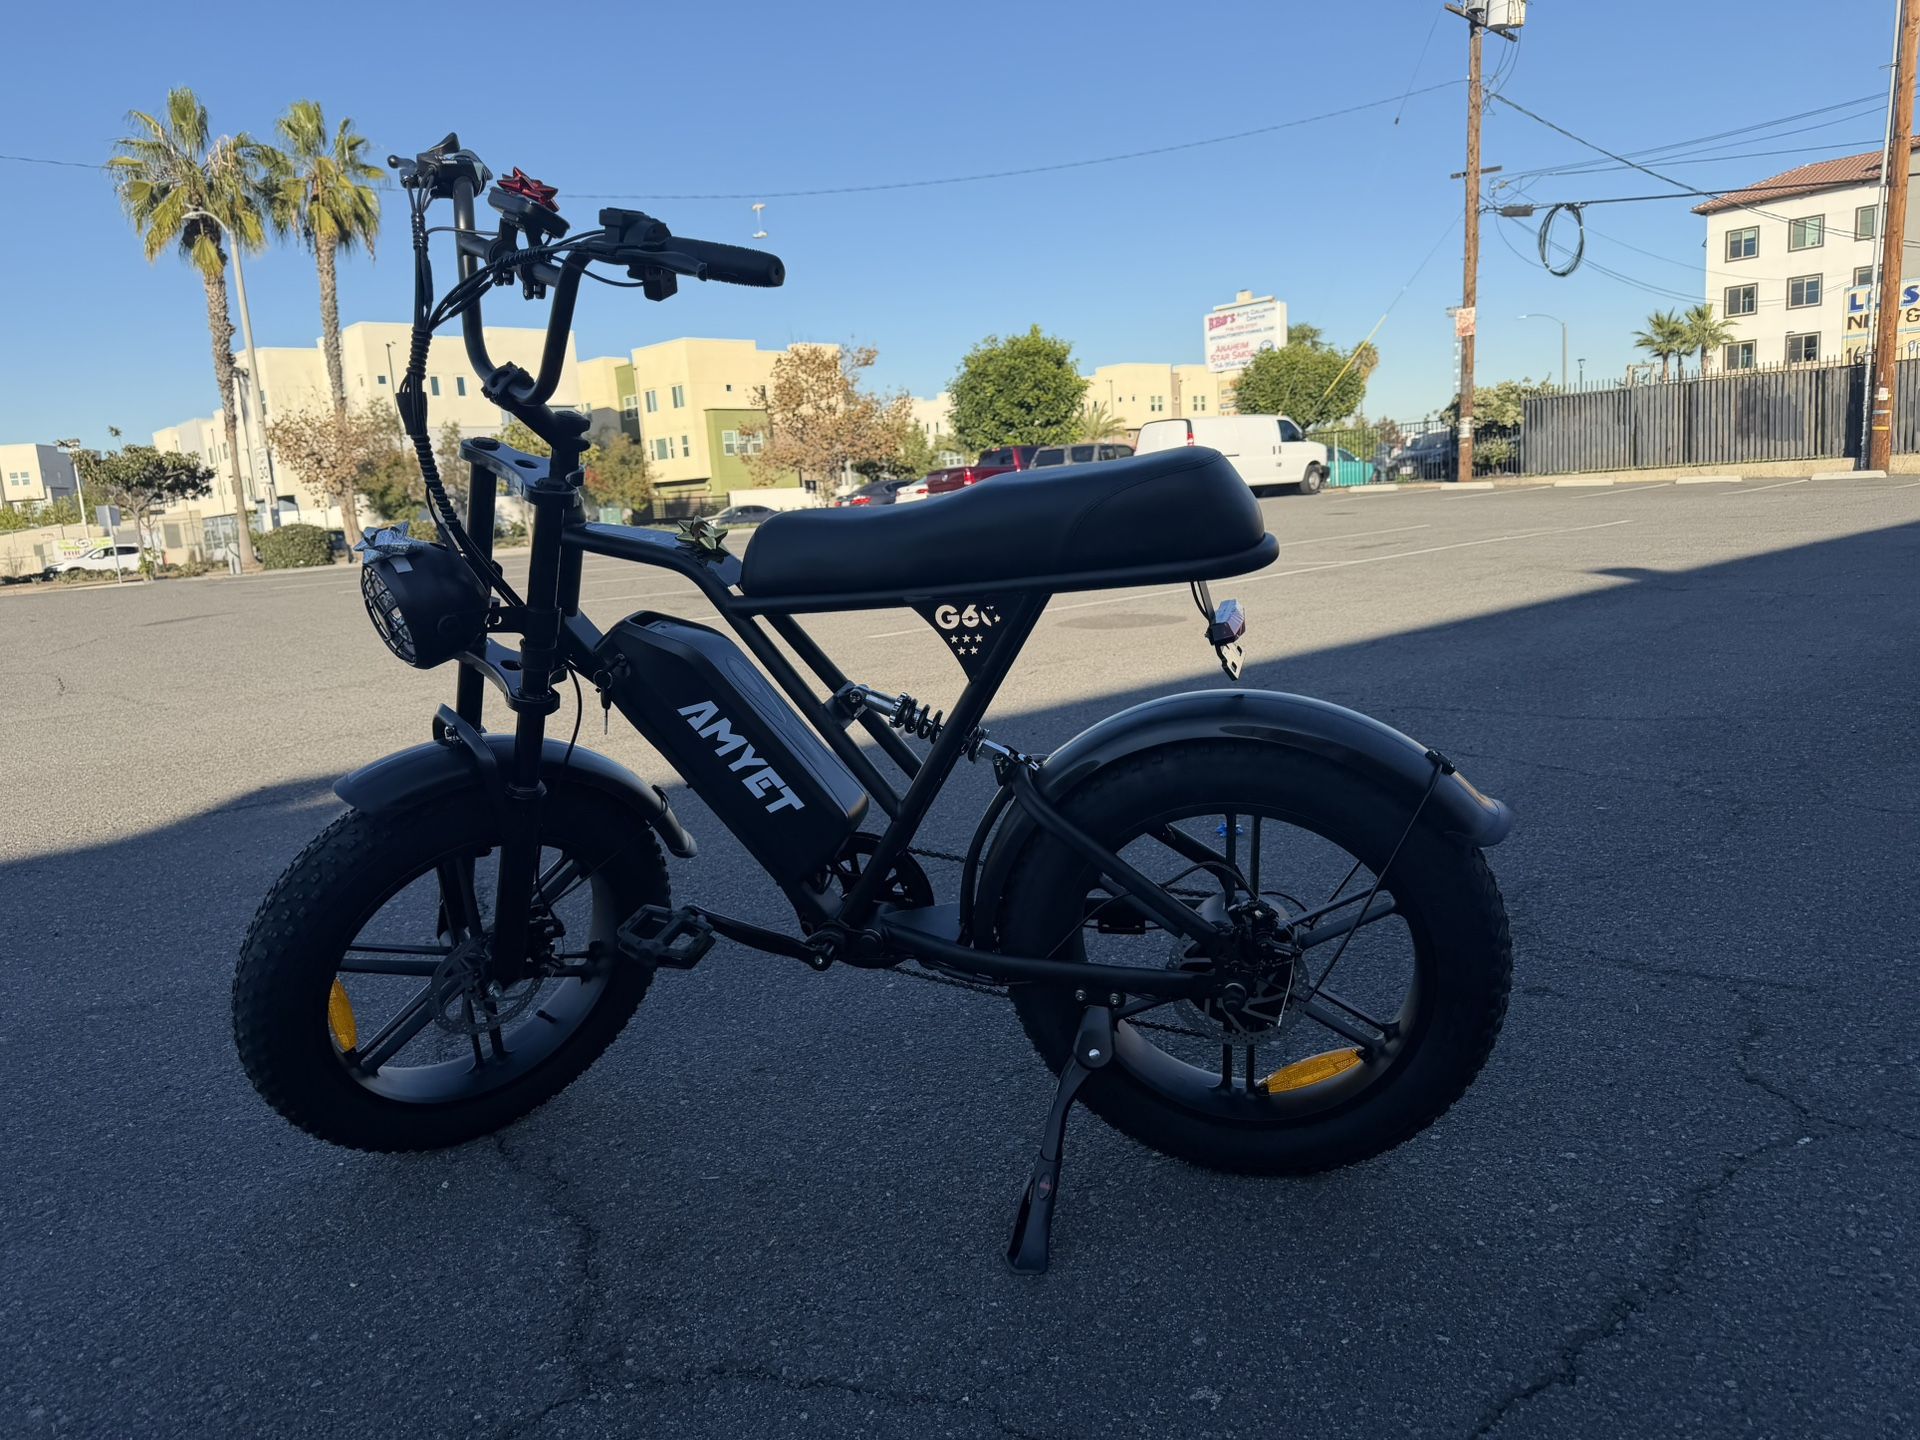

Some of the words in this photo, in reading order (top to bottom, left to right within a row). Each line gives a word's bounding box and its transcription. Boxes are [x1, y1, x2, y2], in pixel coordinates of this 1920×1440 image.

[1216, 341, 1249, 352] ANAHEIM
[1211, 353, 1230, 363] STAR
[677, 700, 805, 814] AMYET
